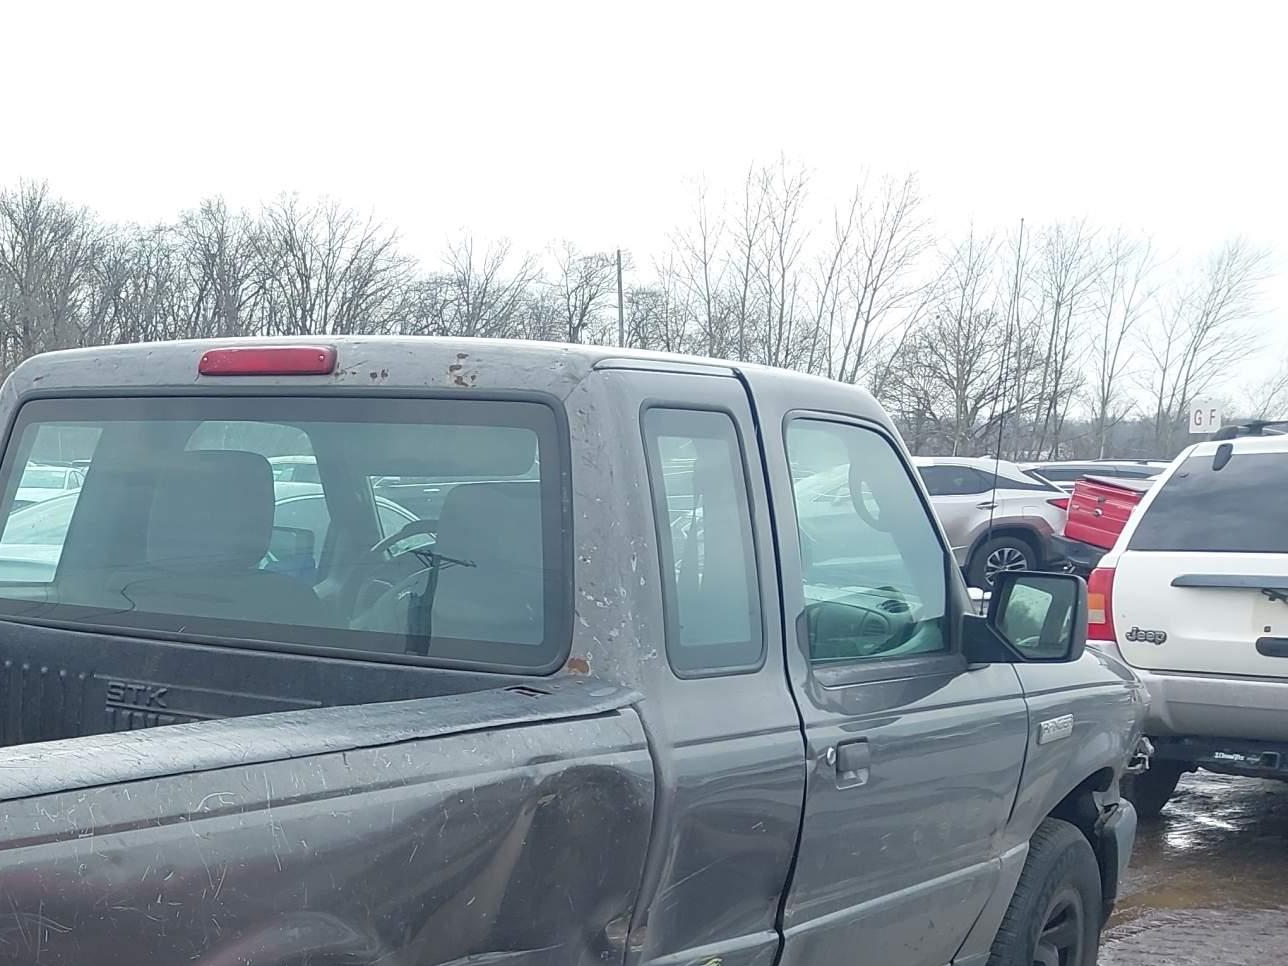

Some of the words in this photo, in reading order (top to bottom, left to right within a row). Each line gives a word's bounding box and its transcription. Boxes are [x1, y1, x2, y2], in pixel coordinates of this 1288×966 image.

[1194, 409, 1203, 426] G
[1209, 408, 1217, 426] F
[1125, 626, 1167, 646] Jeep
